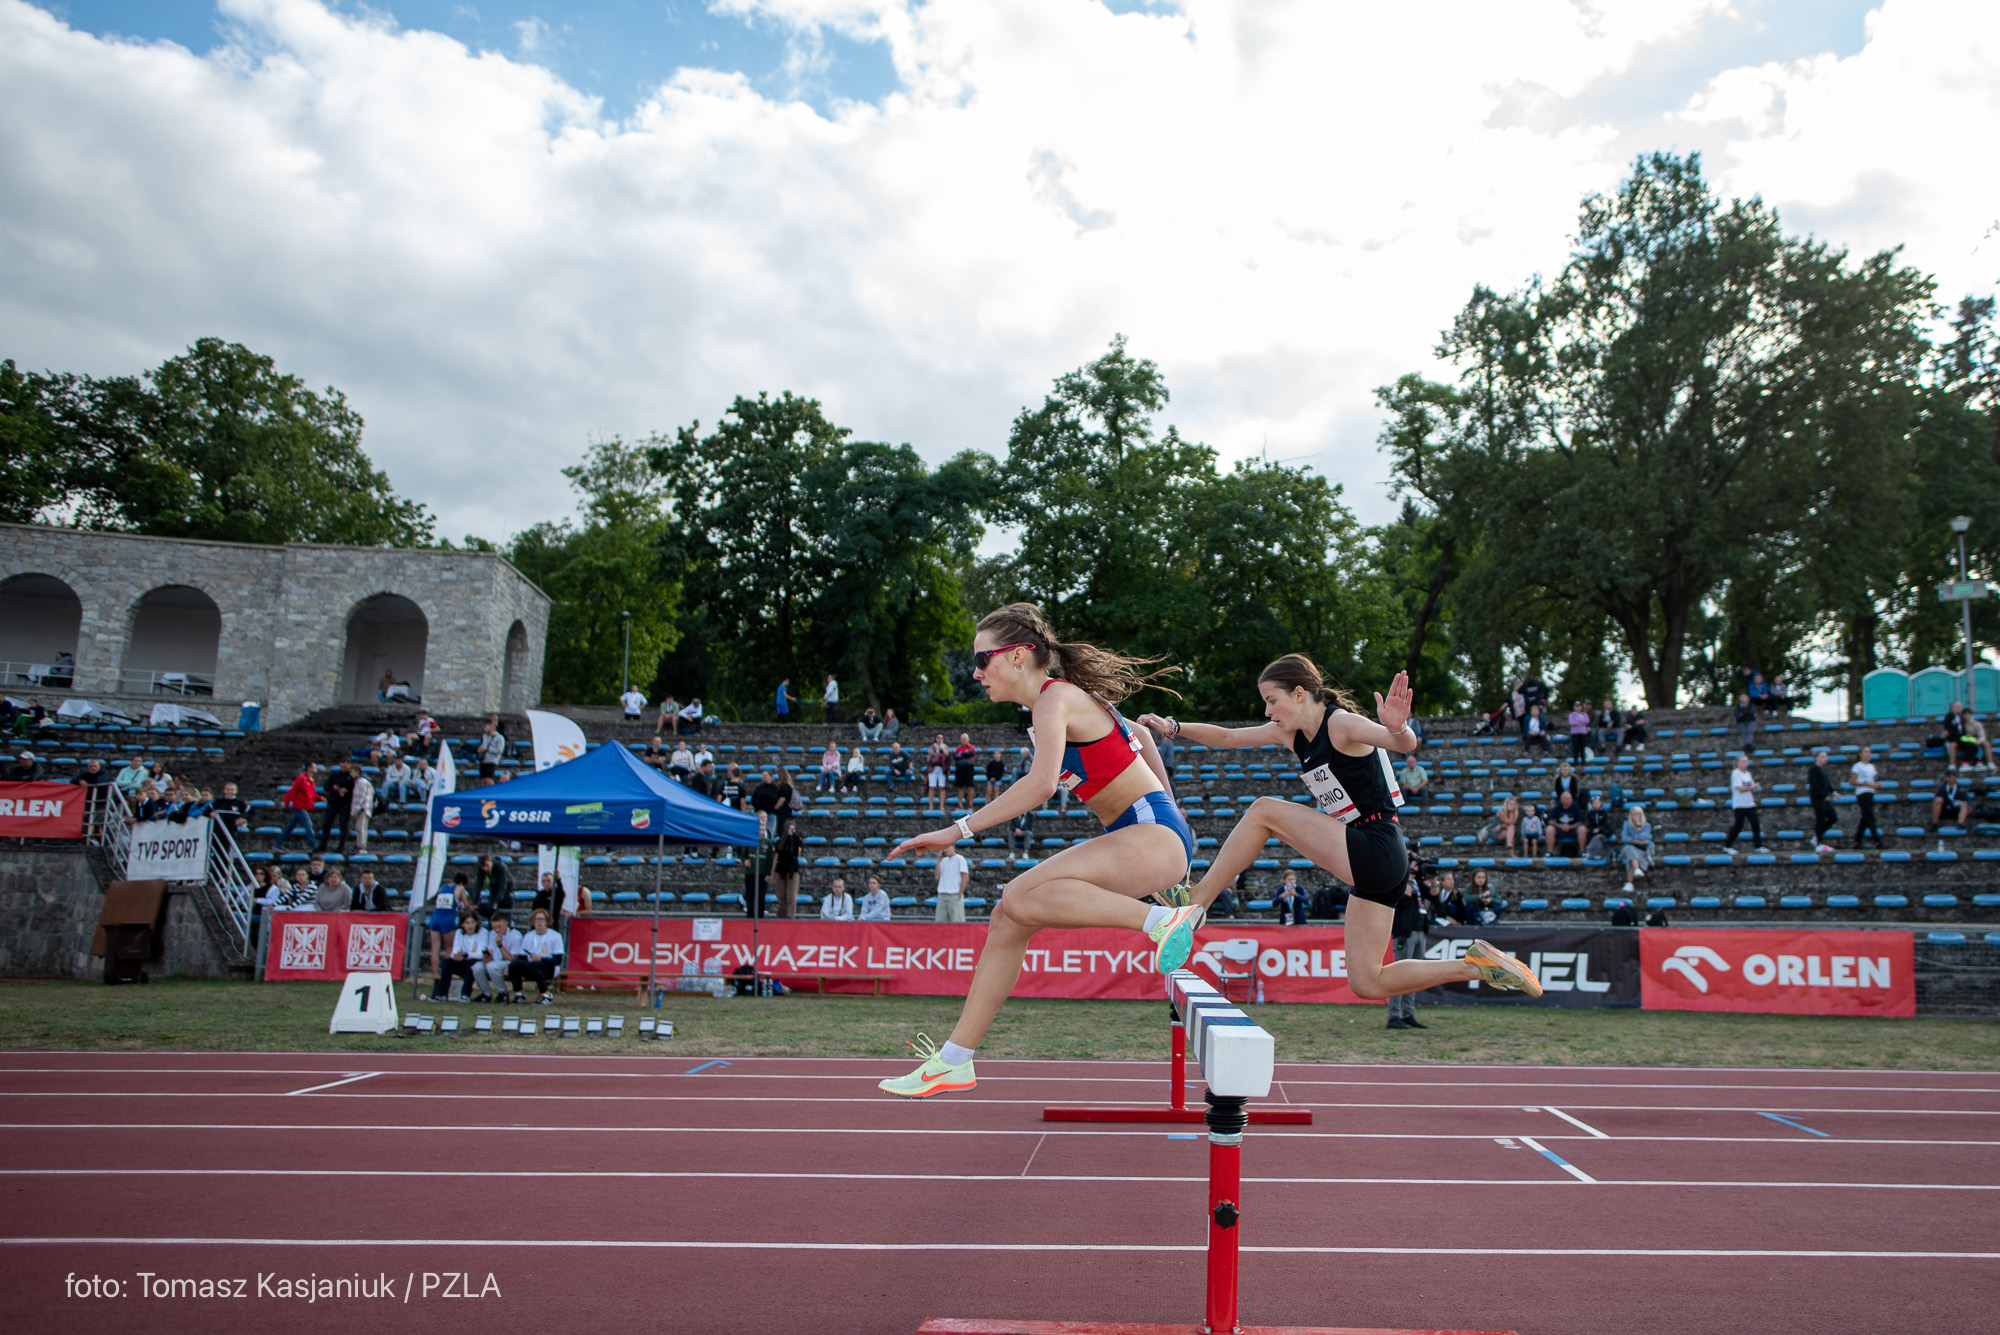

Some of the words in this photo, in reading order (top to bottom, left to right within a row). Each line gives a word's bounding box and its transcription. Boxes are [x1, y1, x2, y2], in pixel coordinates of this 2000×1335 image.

[1313, 769, 1329, 784] 402
[0, 798, 63, 817] RLEN
[138, 841, 160, 861] TVP
[160, 838, 200, 860] SPORT
[284, 953, 321, 966] PZLA
[349, 953, 388, 967] PZLA
[587, 941, 700, 965] POLSKI
[710, 944, 859, 971] ZWIĄZEK
[867, 946, 978, 971] LEKKIE
[1258, 948, 1348, 977] ORLE
[1743, 953, 1890, 989] ORLEN
[355, 985, 371, 1012] 1
